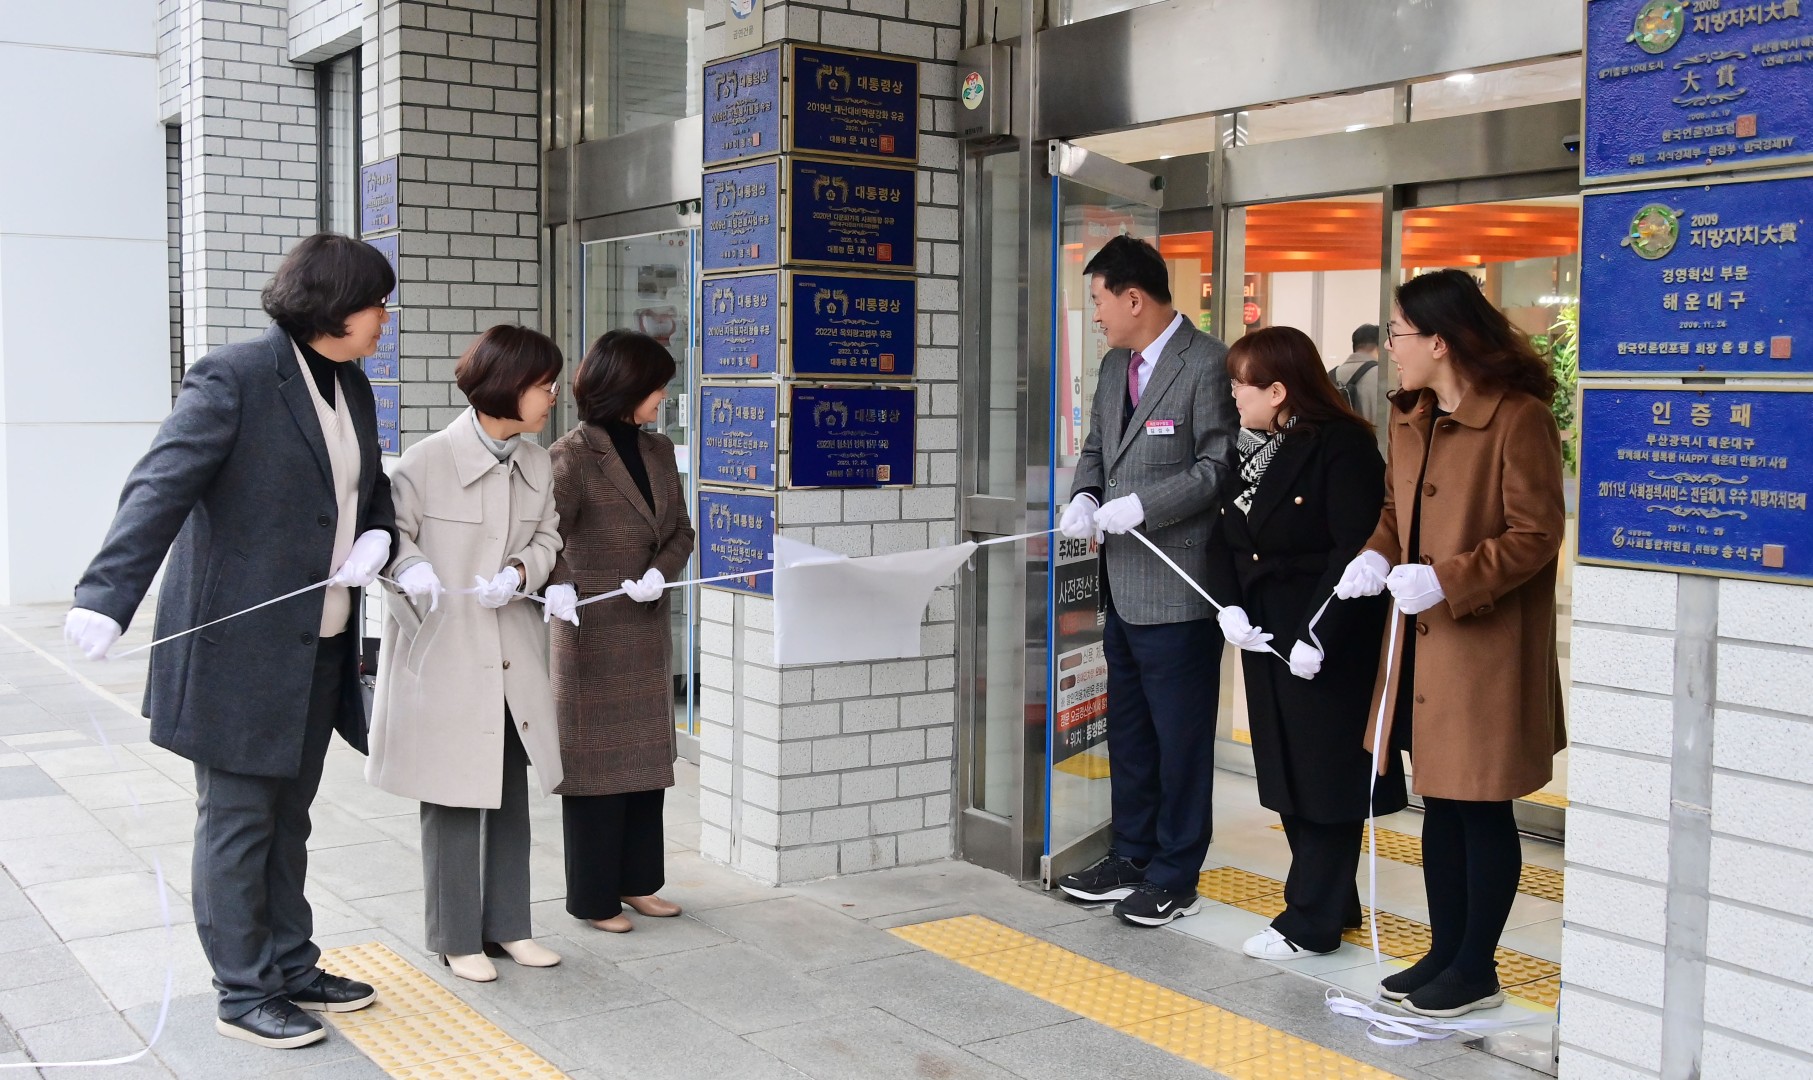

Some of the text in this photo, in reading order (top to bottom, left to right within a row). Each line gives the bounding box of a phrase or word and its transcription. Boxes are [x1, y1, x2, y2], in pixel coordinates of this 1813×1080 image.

[858, 76, 903, 94] 대통령상
[807, 102, 832, 113] 2019년
[855, 186, 900, 202] 대통령상
[1691, 213, 1718, 227] 2009
[1662, 266, 1748, 284] 경영혁신 부문
[855, 298, 900, 313] 대통령상
[815, 328, 837, 336] 2022년
[1617, 341, 1689, 355] 한국언론인포럼
[1646, 433, 1755, 450] 부산광역시 해운대구
[1678, 453, 1708, 464] HAPPY
[1769, 457, 1787, 469] 사업
[1599, 481, 1626, 498] 2011년
[1729, 488, 1748, 505] 우수
[1750, 489, 1807, 510] 지방자치단체
[734, 513, 763, 529] 대통령상
[1059, 538, 1086, 560] 주차요금
[1059, 575, 1092, 604] 사전정산
